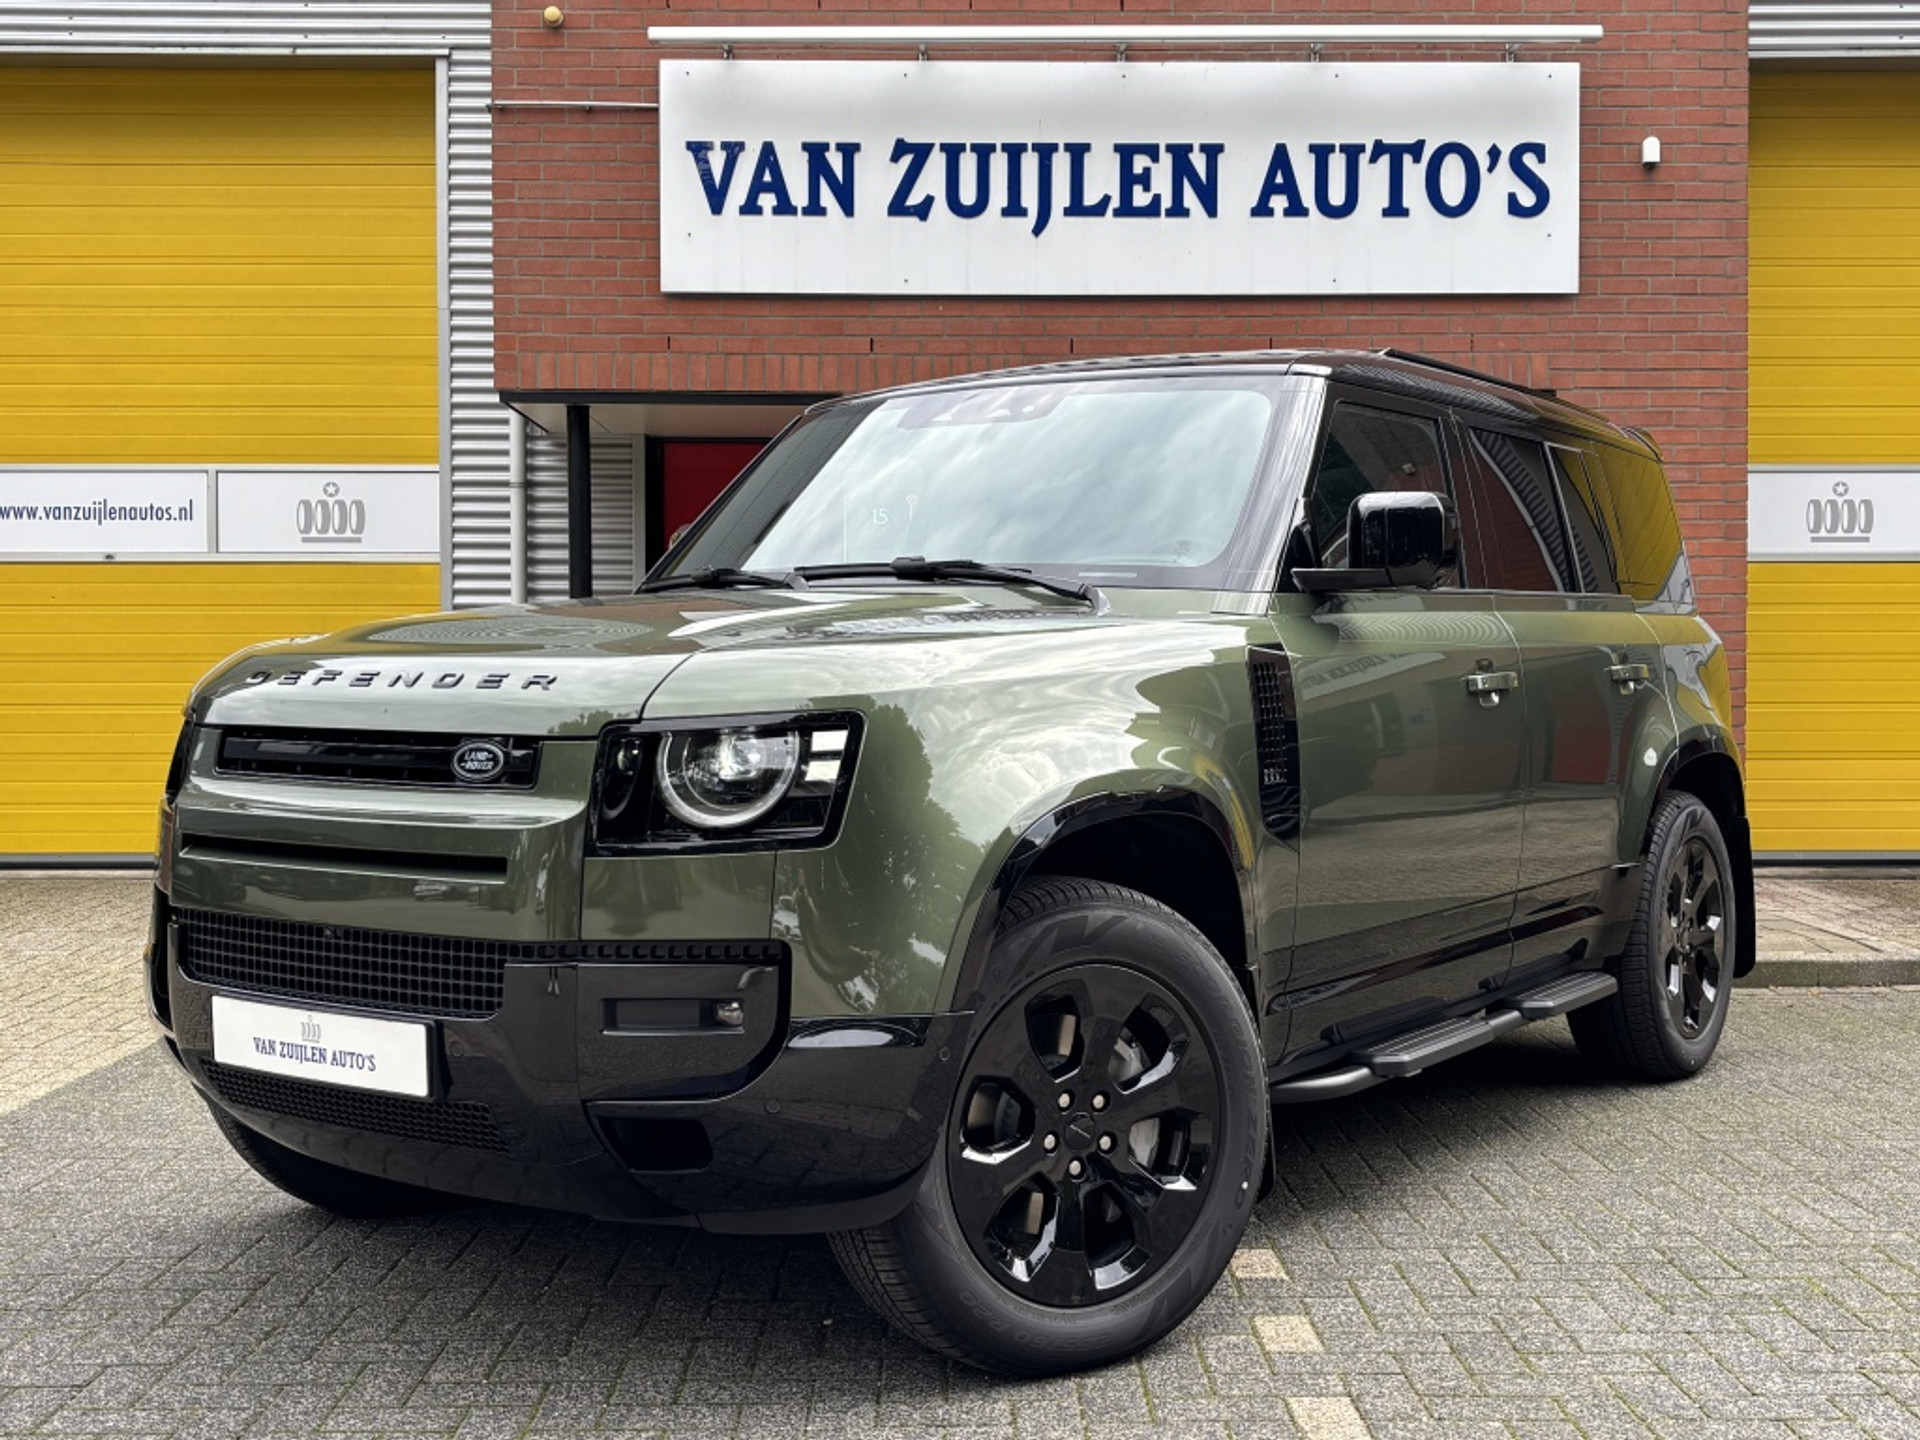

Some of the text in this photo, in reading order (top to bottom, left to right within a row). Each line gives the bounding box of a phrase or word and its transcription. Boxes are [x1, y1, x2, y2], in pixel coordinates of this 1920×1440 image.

[684, 137, 1551, 239] VAN ZUIJLEN AUTO'S
[0, 499, 193, 526] www.vanzuijlenautos.nl
[872, 508, 888, 524] 15
[245, 669, 557, 690] DEFENDER
[253, 1036, 377, 1072] VAN ZUIJLEN AUTO'S
